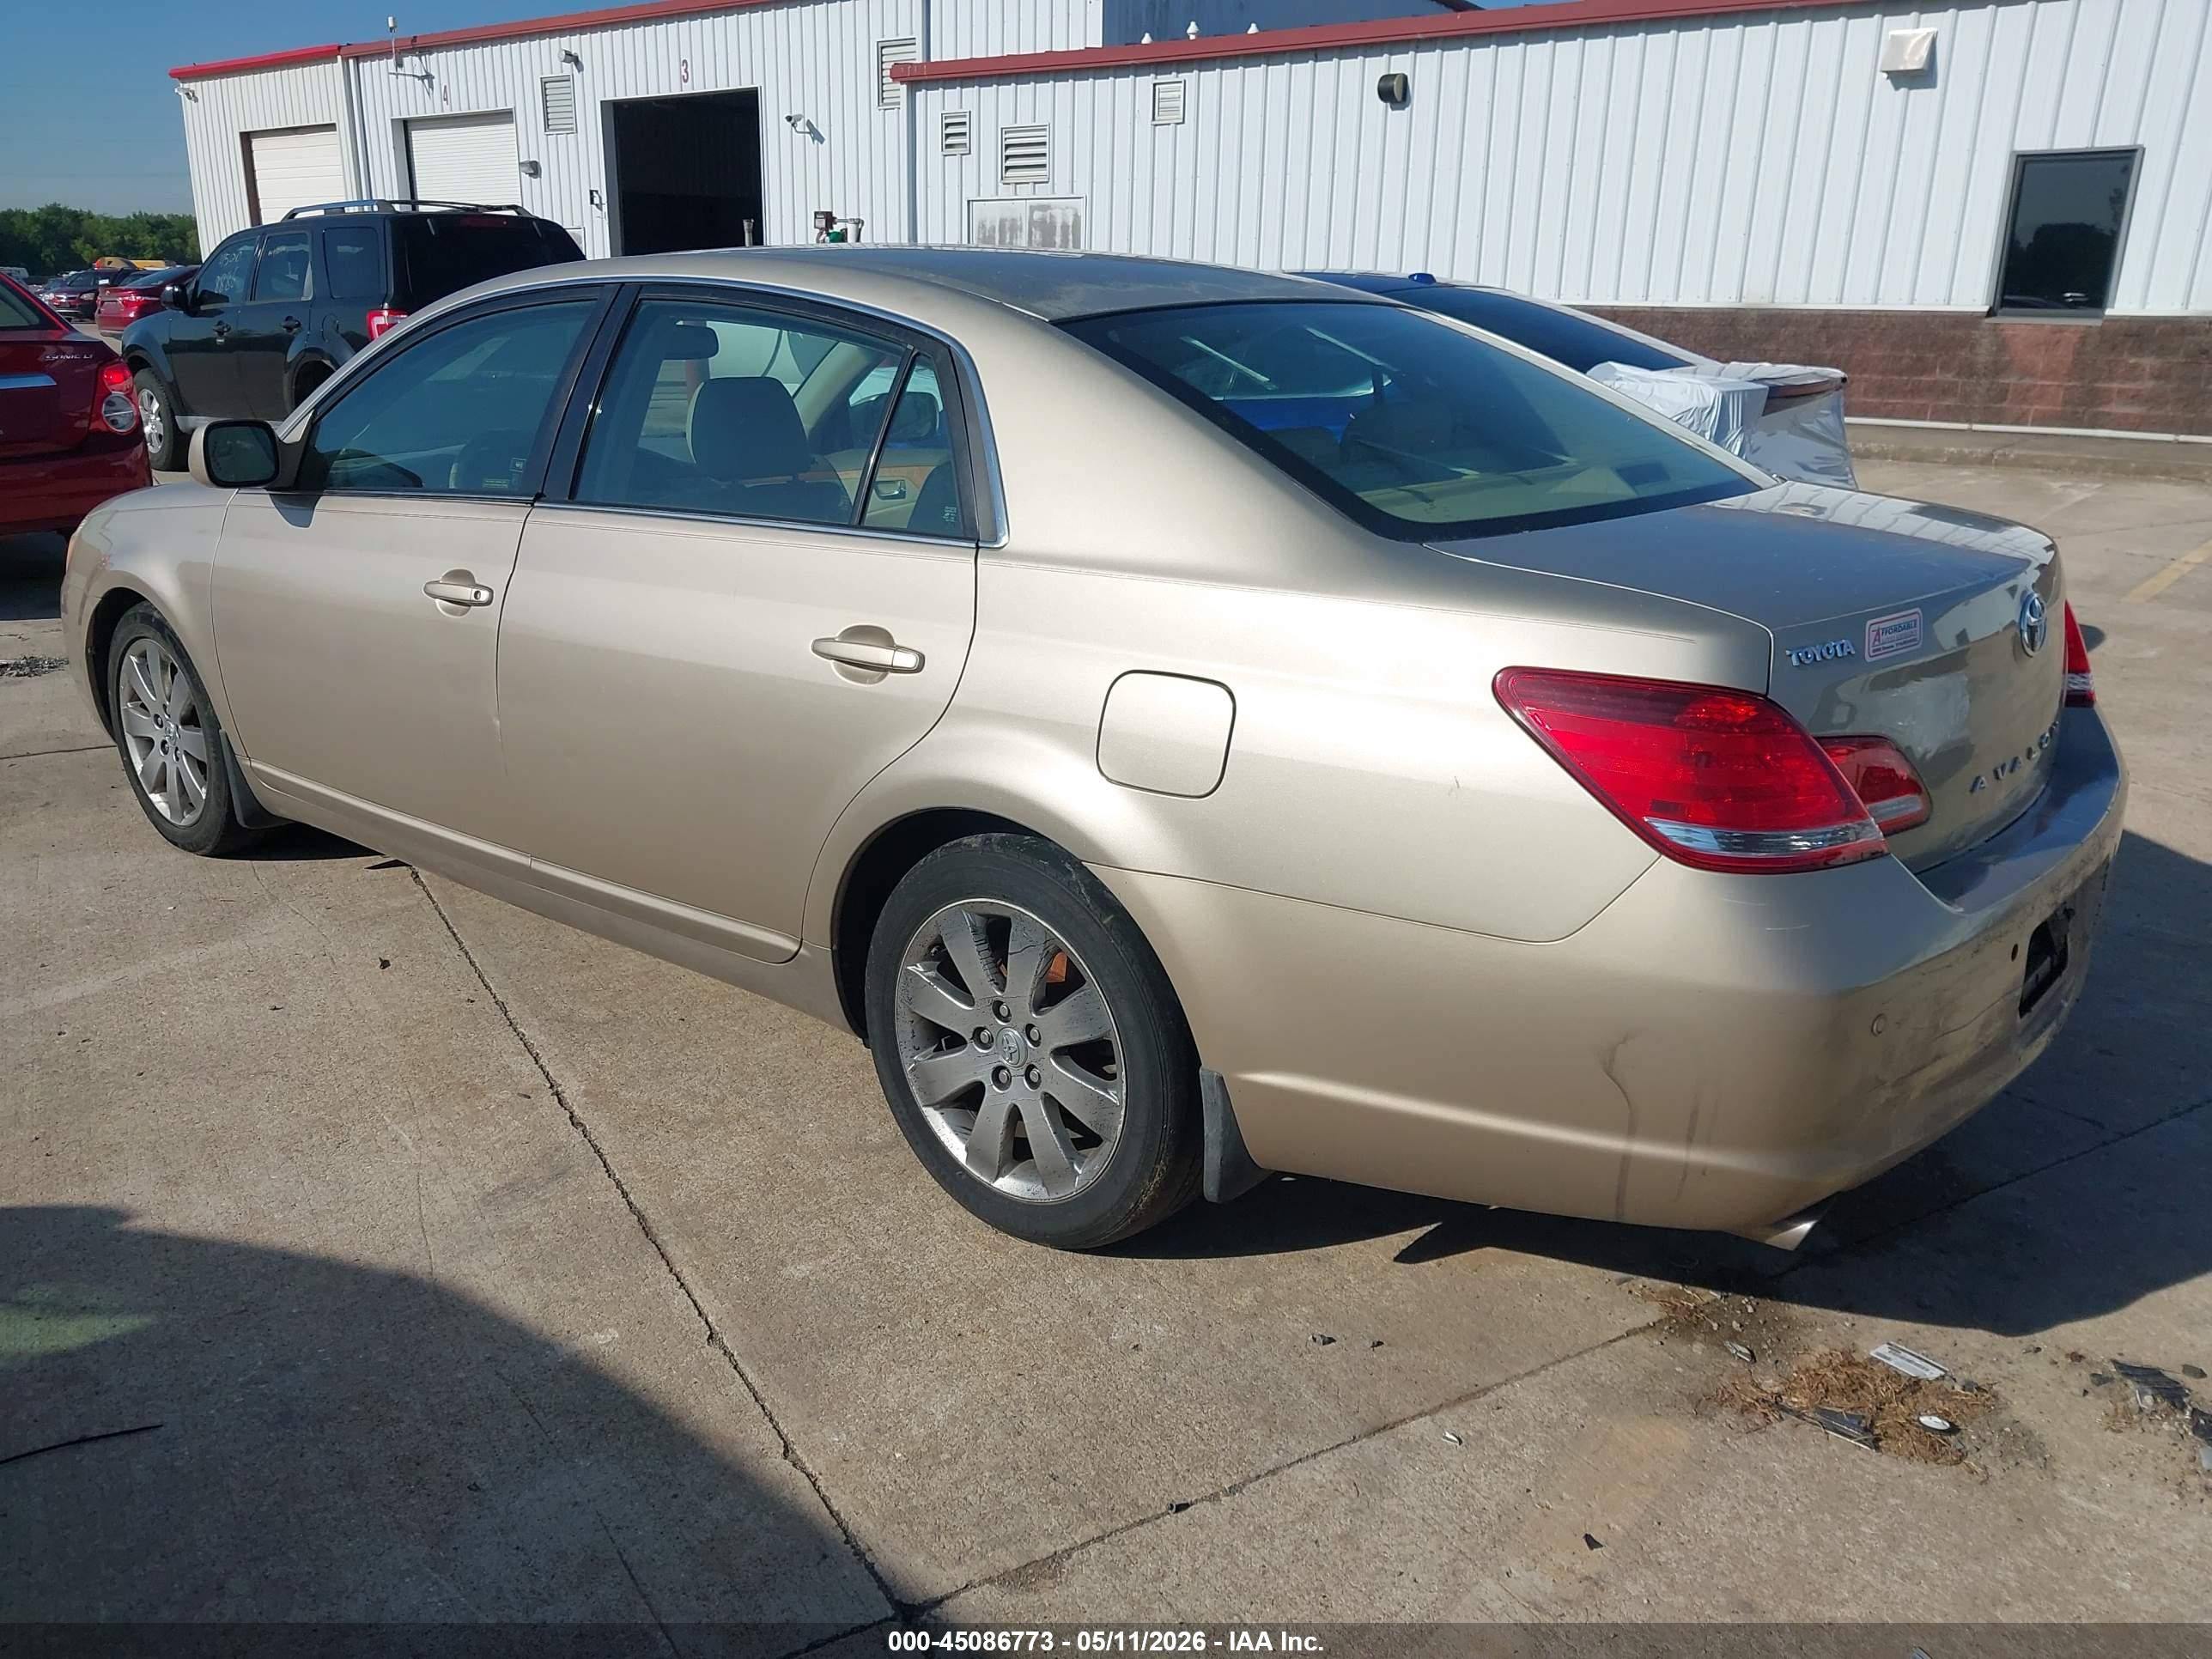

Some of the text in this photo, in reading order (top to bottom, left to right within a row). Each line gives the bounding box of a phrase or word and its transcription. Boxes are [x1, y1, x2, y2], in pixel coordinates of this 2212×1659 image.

[681, 59, 690, 83] 3
[442, 85, 449, 105] 4
[1785, 640, 1856, 666] TOYOTA
